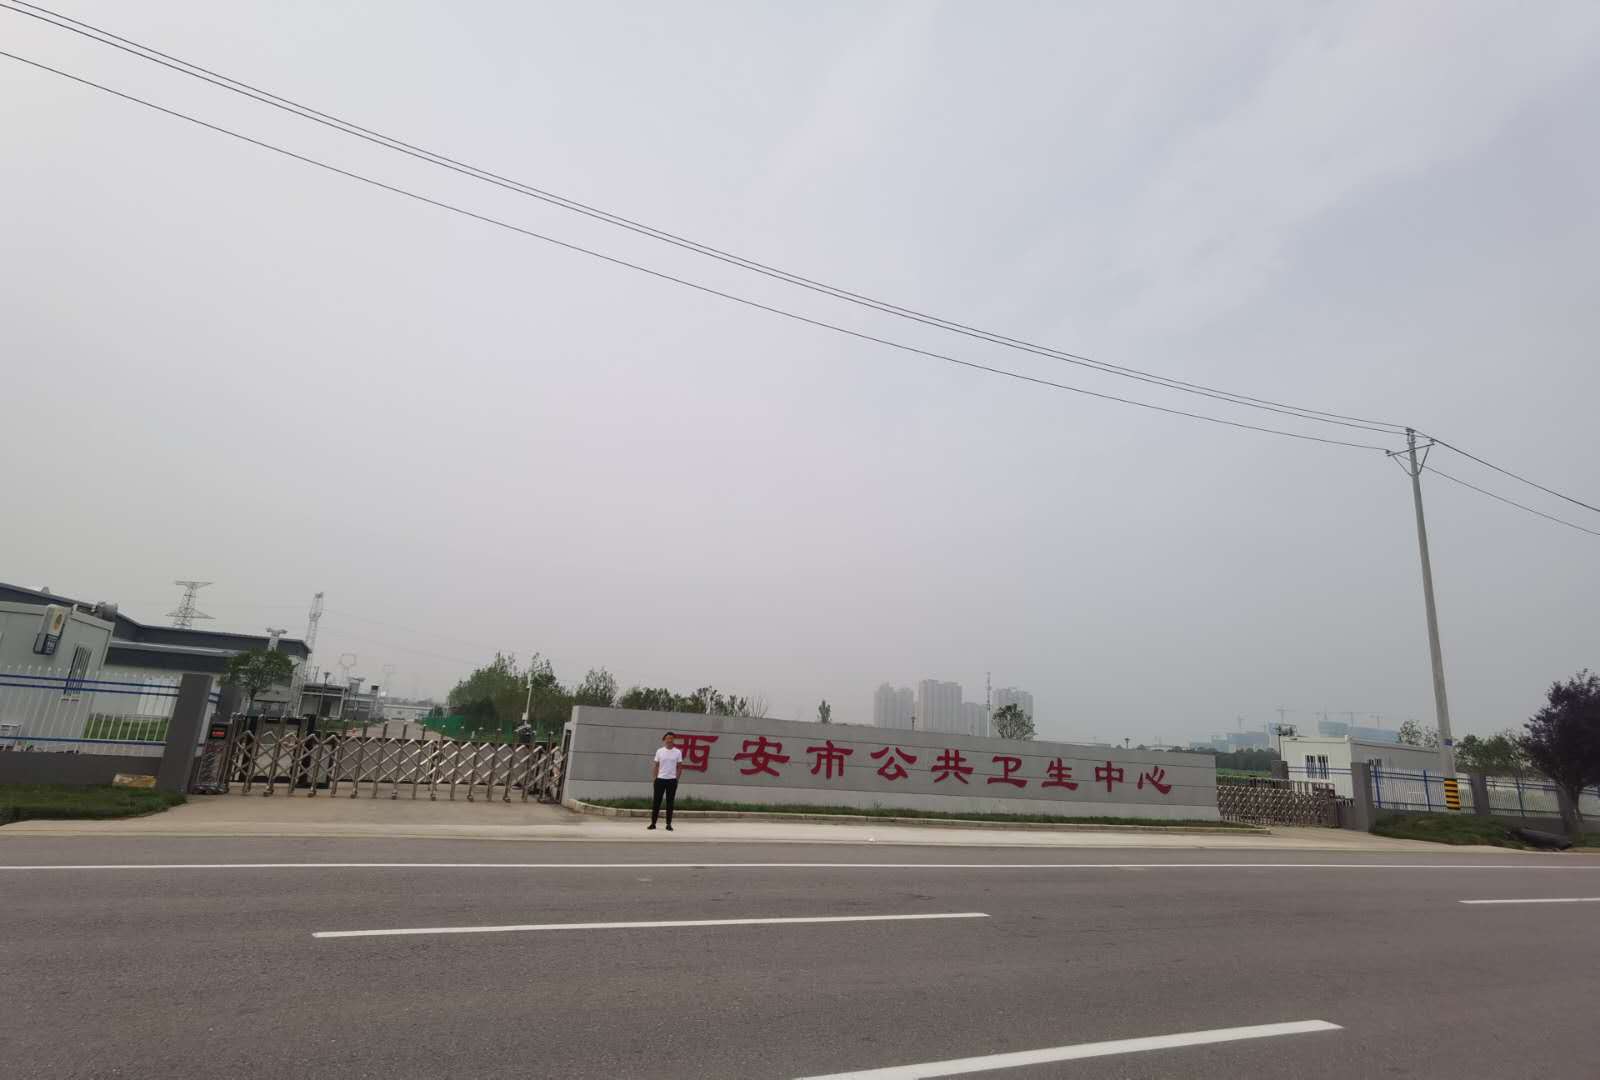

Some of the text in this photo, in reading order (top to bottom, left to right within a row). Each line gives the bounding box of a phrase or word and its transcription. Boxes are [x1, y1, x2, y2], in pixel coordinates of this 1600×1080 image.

[672, 733, 1172, 795] 西安市公共卫生中心
